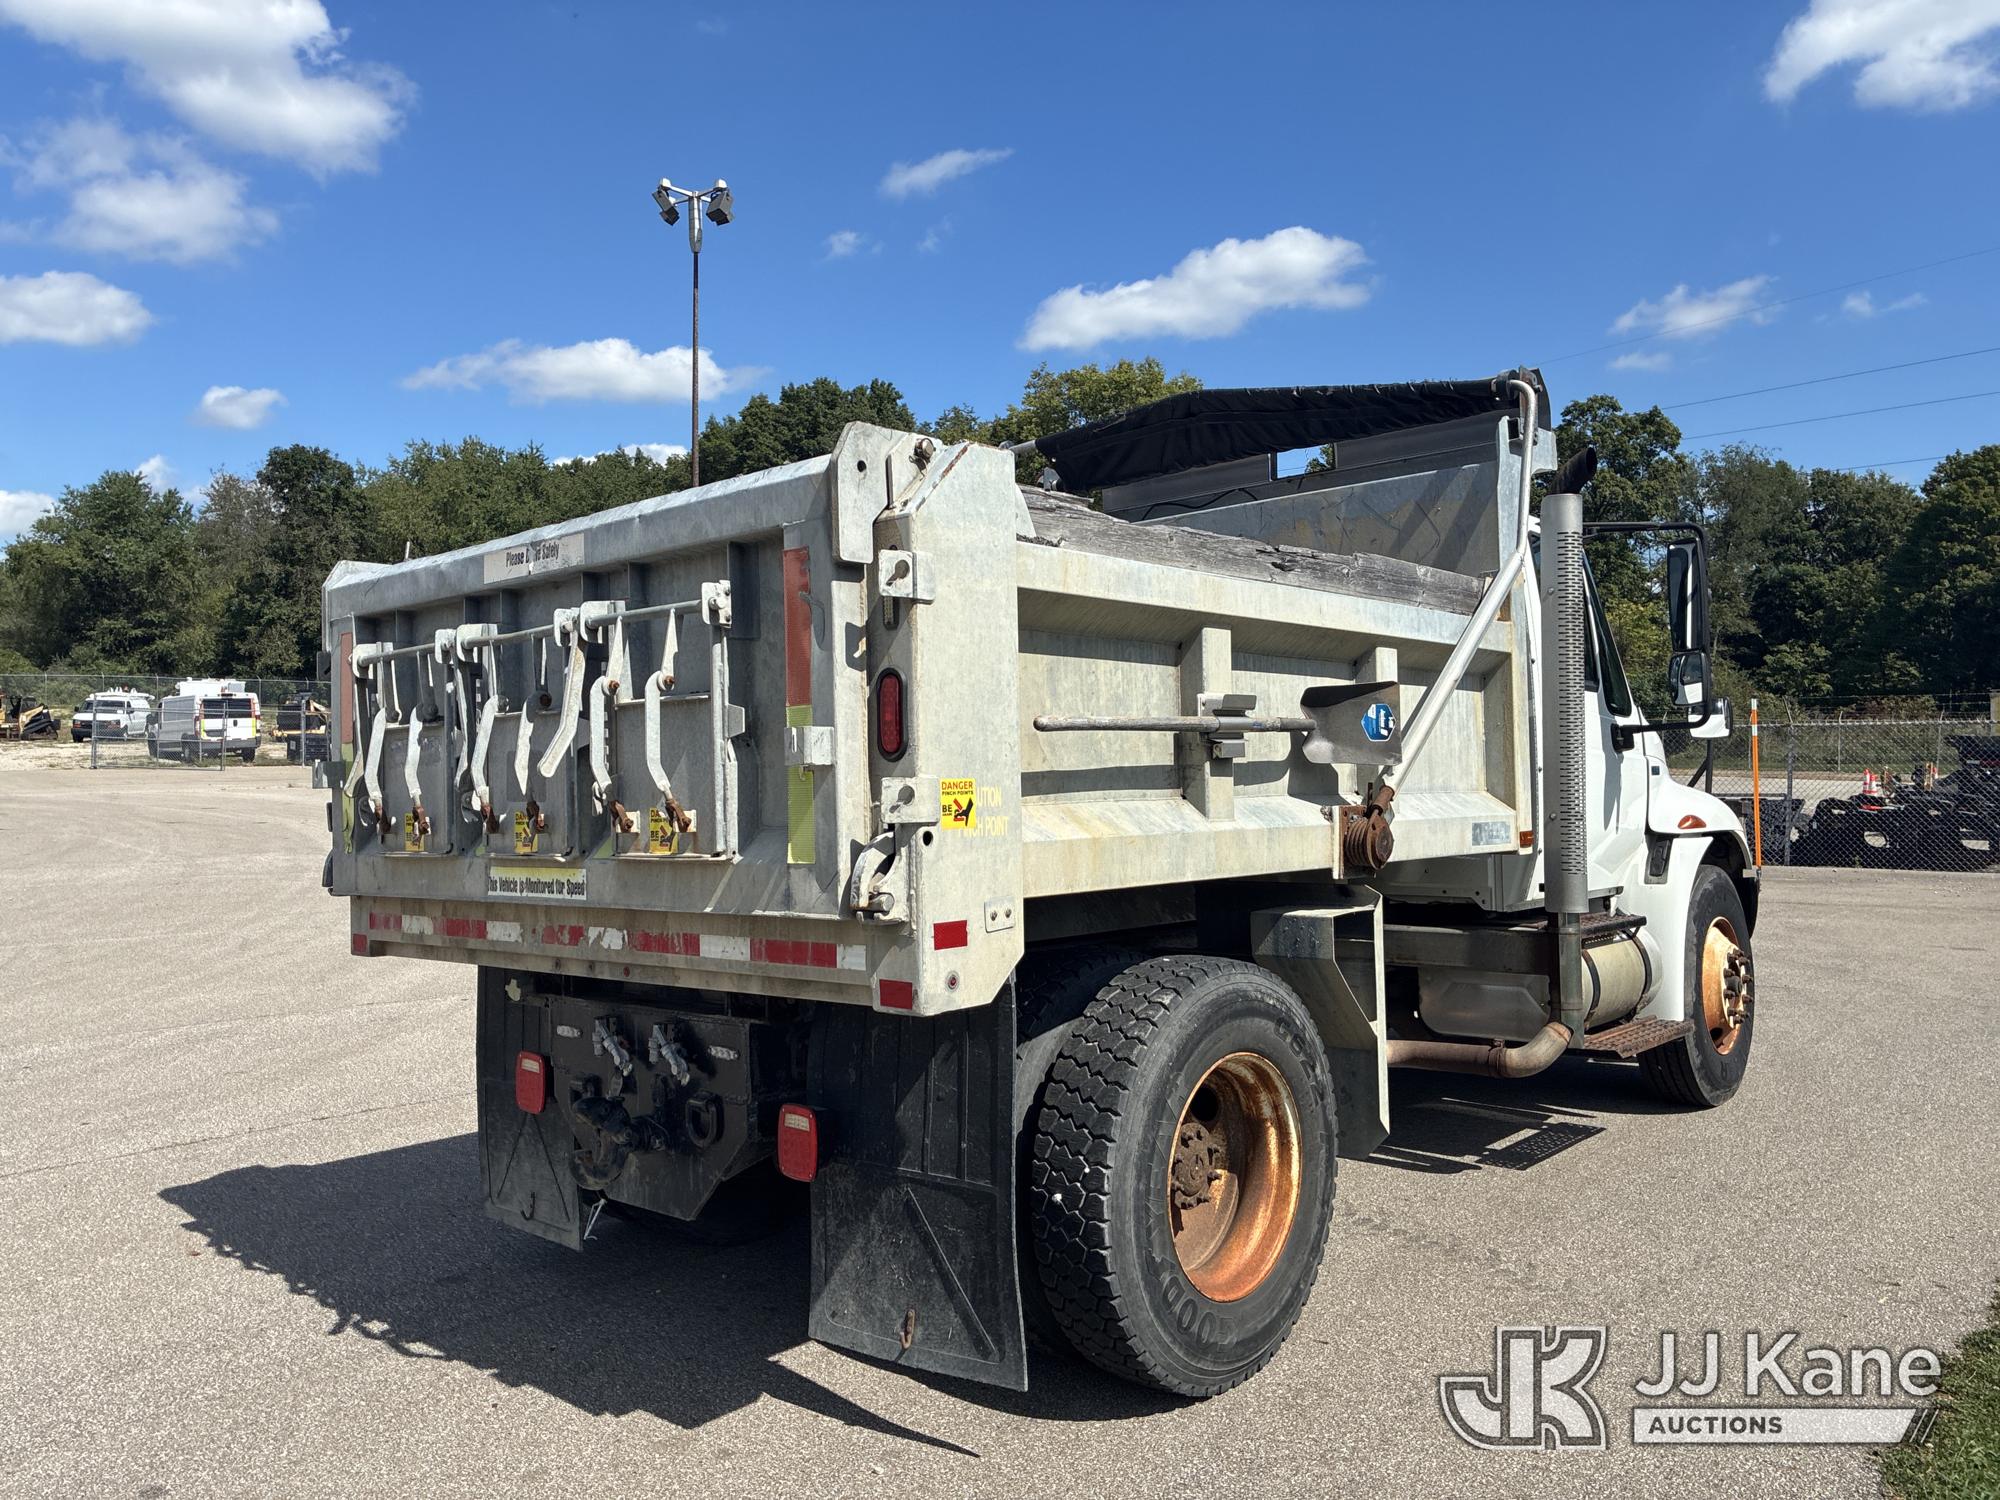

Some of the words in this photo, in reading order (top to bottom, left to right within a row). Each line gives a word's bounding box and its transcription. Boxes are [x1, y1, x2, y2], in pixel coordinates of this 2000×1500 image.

[506, 551, 525, 568] Please
[542, 541, 560, 561] Safely
[941, 781, 973, 790] DANGER
[977, 785, 1002, 808] UTION
[942, 804, 952, 812] BE
[985, 816, 1009, 837] POINT
[499, 876, 518, 893] Vehicle
[525, 876, 554, 894] Monitored
[555, 878, 565, 895] for
[566, 878, 585, 898] Speed
